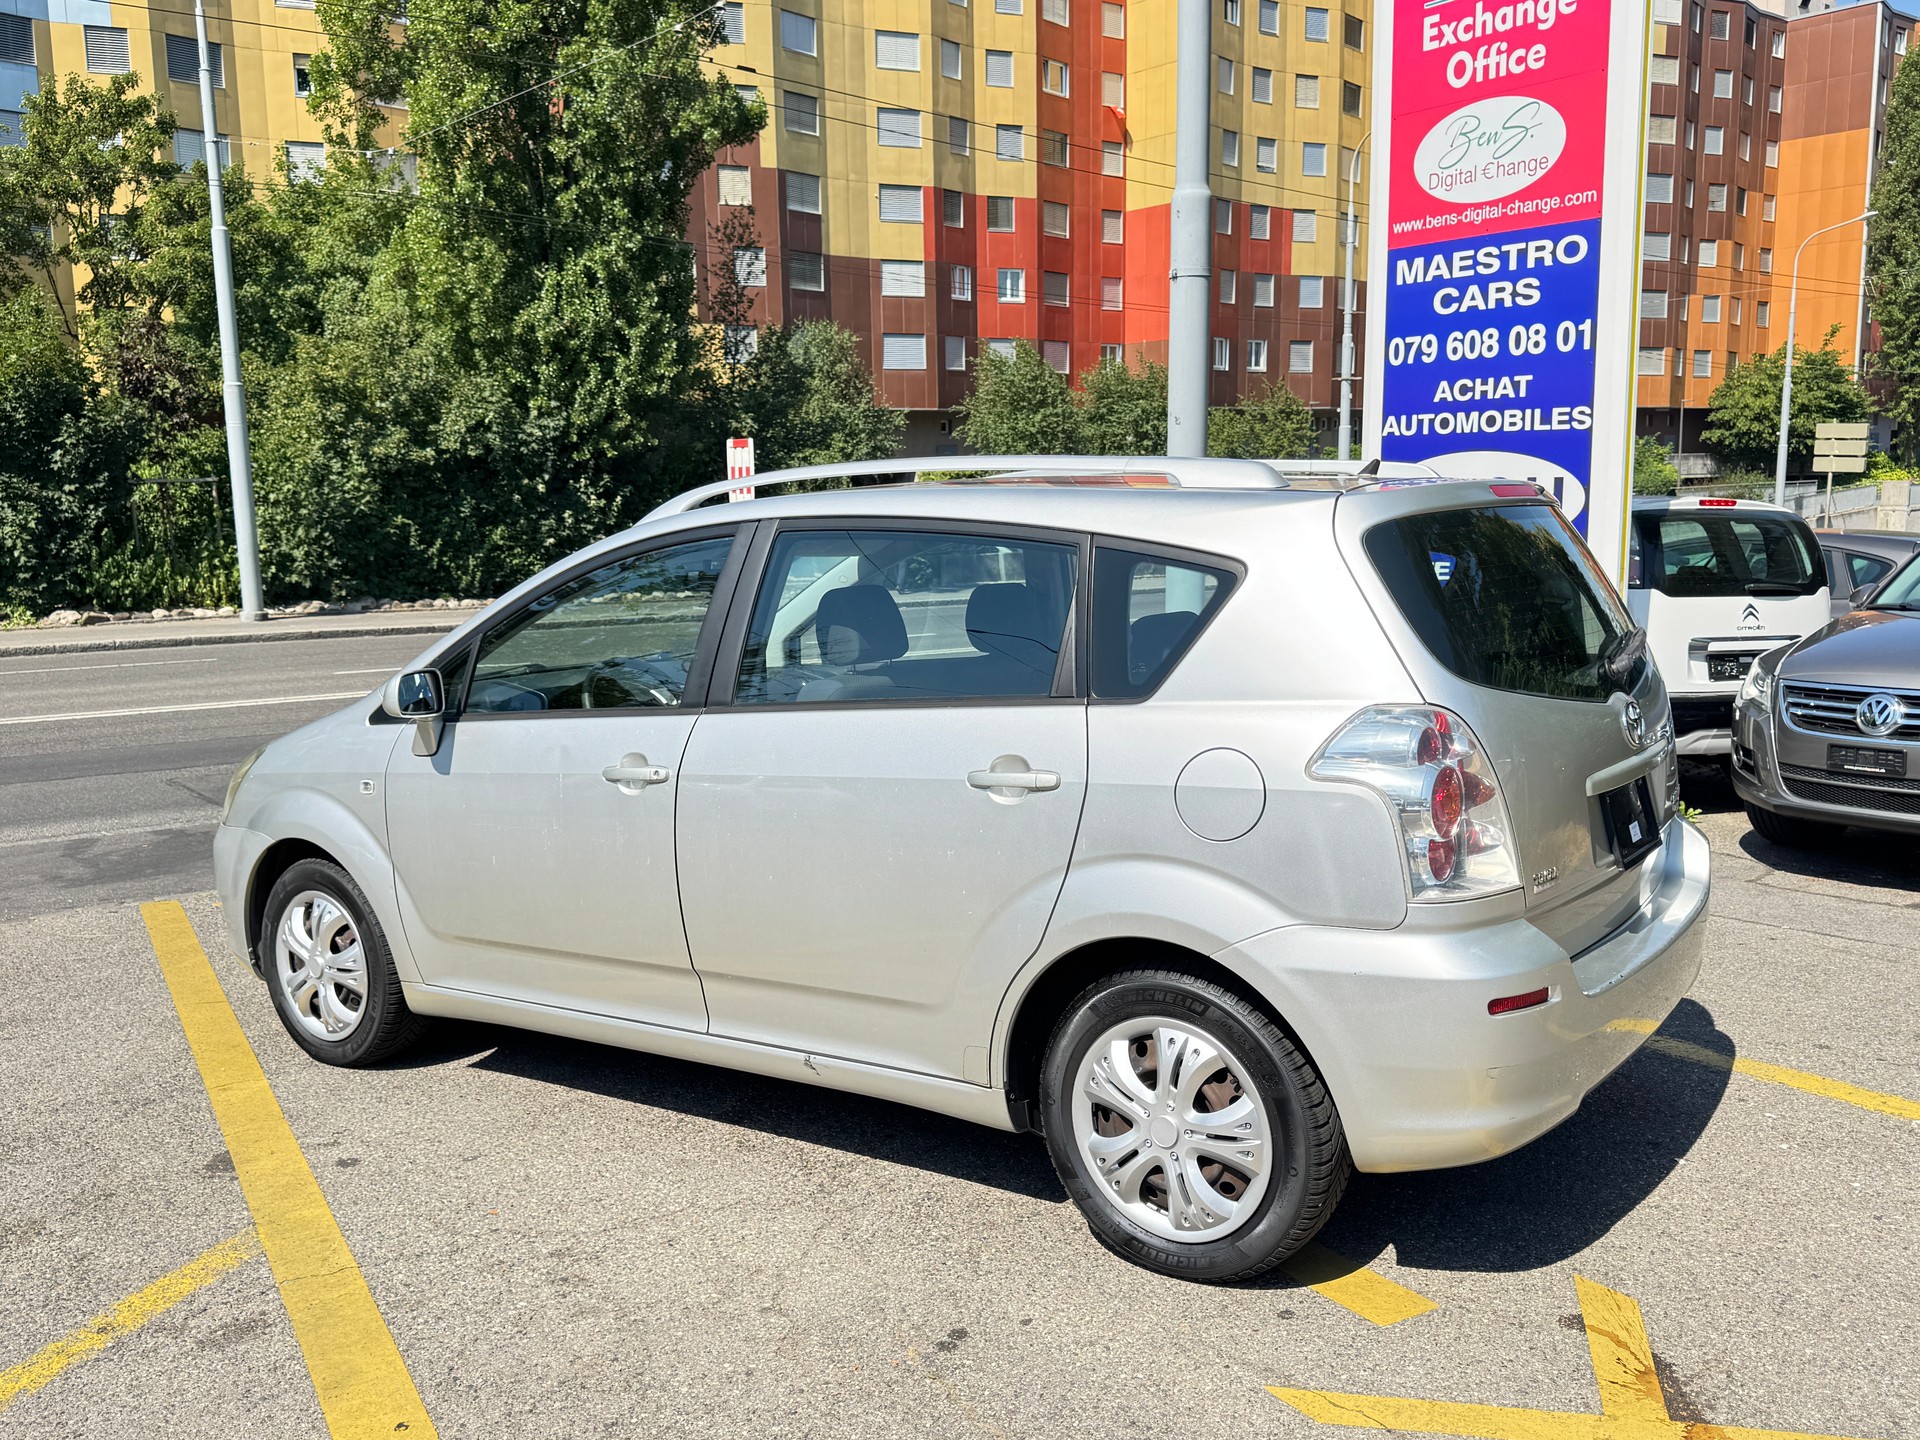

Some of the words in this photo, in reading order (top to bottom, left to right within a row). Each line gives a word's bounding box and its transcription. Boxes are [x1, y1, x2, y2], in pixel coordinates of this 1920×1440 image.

[1422, 0, 1577, 51] Exchange
[1446, 42, 1547, 88] Office
[1429, 165, 1477, 191] Digital
[1393, 190, 1597, 234] www.bens-digital-change.com
[1396, 235, 1588, 285] MAESTRO
[1433, 278, 1541, 315] CARS
[1388, 334, 1438, 366] 079
[1446, 328, 1499, 361] 608
[1508, 324, 1546, 356] 08
[1556, 319, 1592, 352] 01
[1433, 374, 1533, 402] ACHAT
[1382, 406, 1592, 437] AUTOMOBILES
[1125, 990, 1206, 1015] MICHELIN
[1130, 1239, 1210, 1269] MICHELIN
